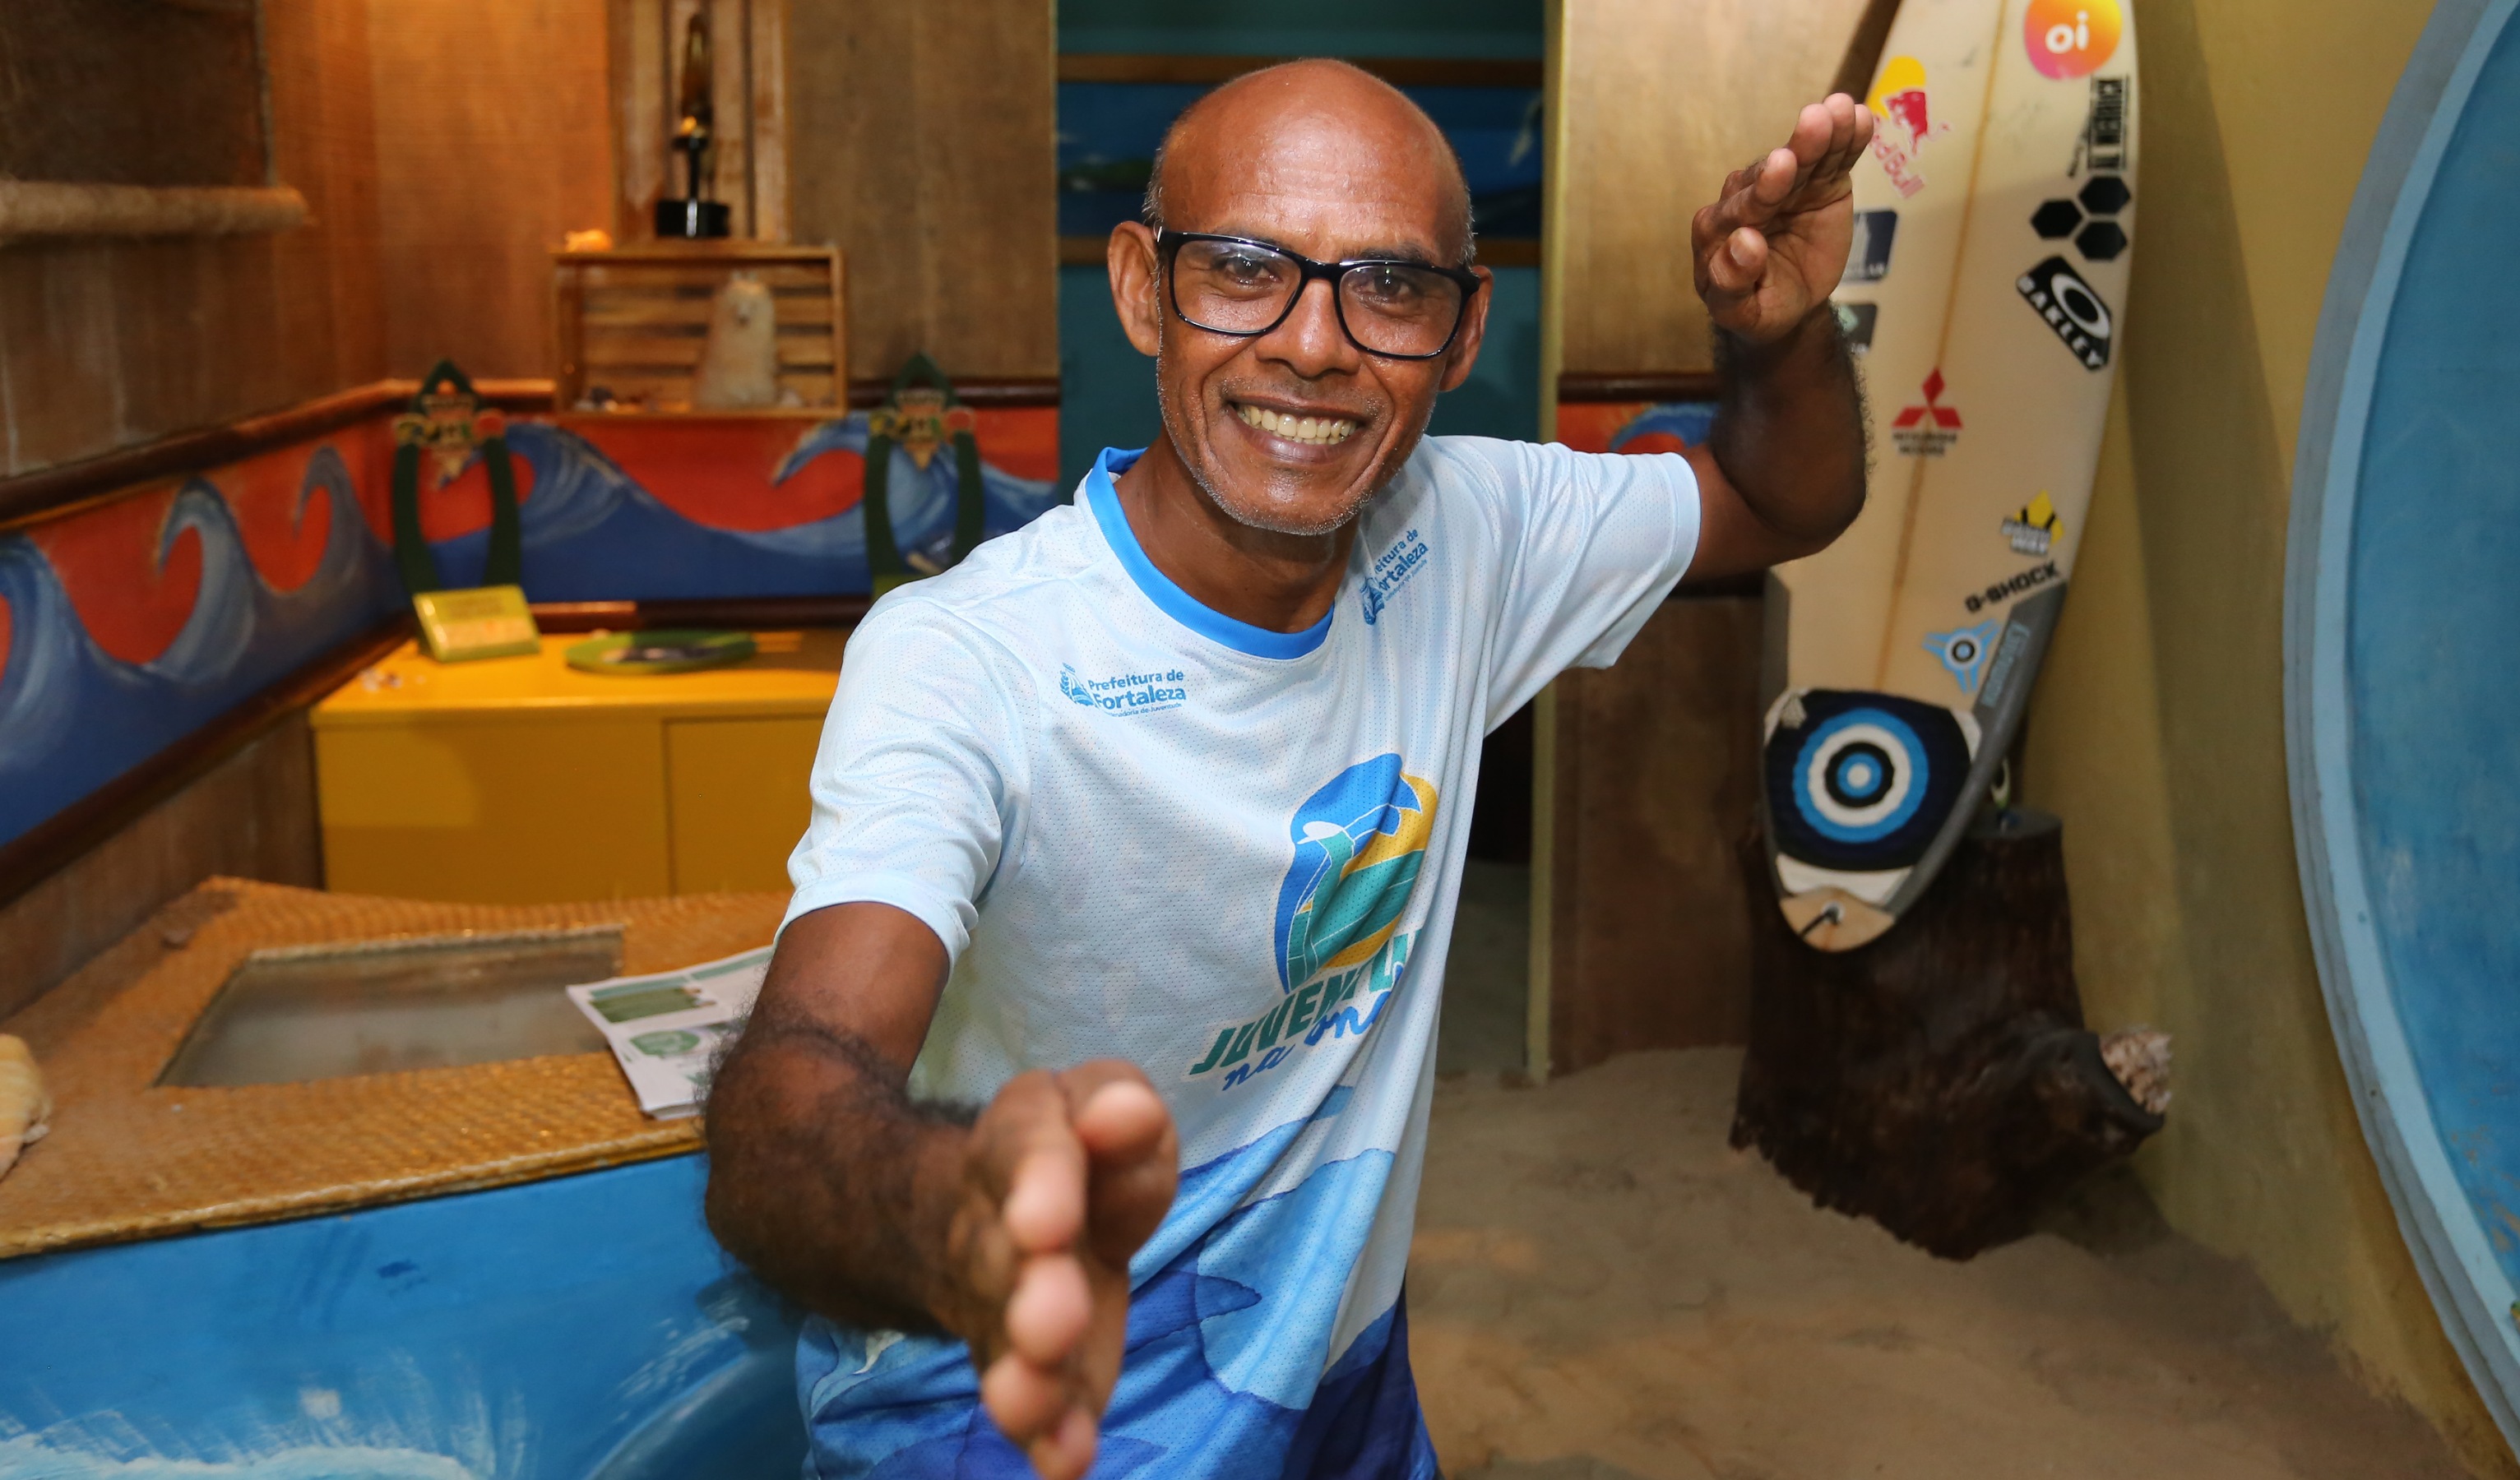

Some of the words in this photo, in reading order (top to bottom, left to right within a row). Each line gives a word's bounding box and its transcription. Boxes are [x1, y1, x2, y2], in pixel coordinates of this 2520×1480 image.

[2045, 10, 2089, 55] oi
[2017, 275, 2105, 367] OAKLEY
[1374, 540, 1406, 574] eitura
[1406, 529, 1419, 542] de
[1378, 542, 1429, 591] ortaleza
[1087, 673, 1163, 691] Prefeitura
[1166, 668, 1185, 682] de
[1092, 684, 1187, 710] Fortaleza
[1222, 1043, 1296, 1091] na
